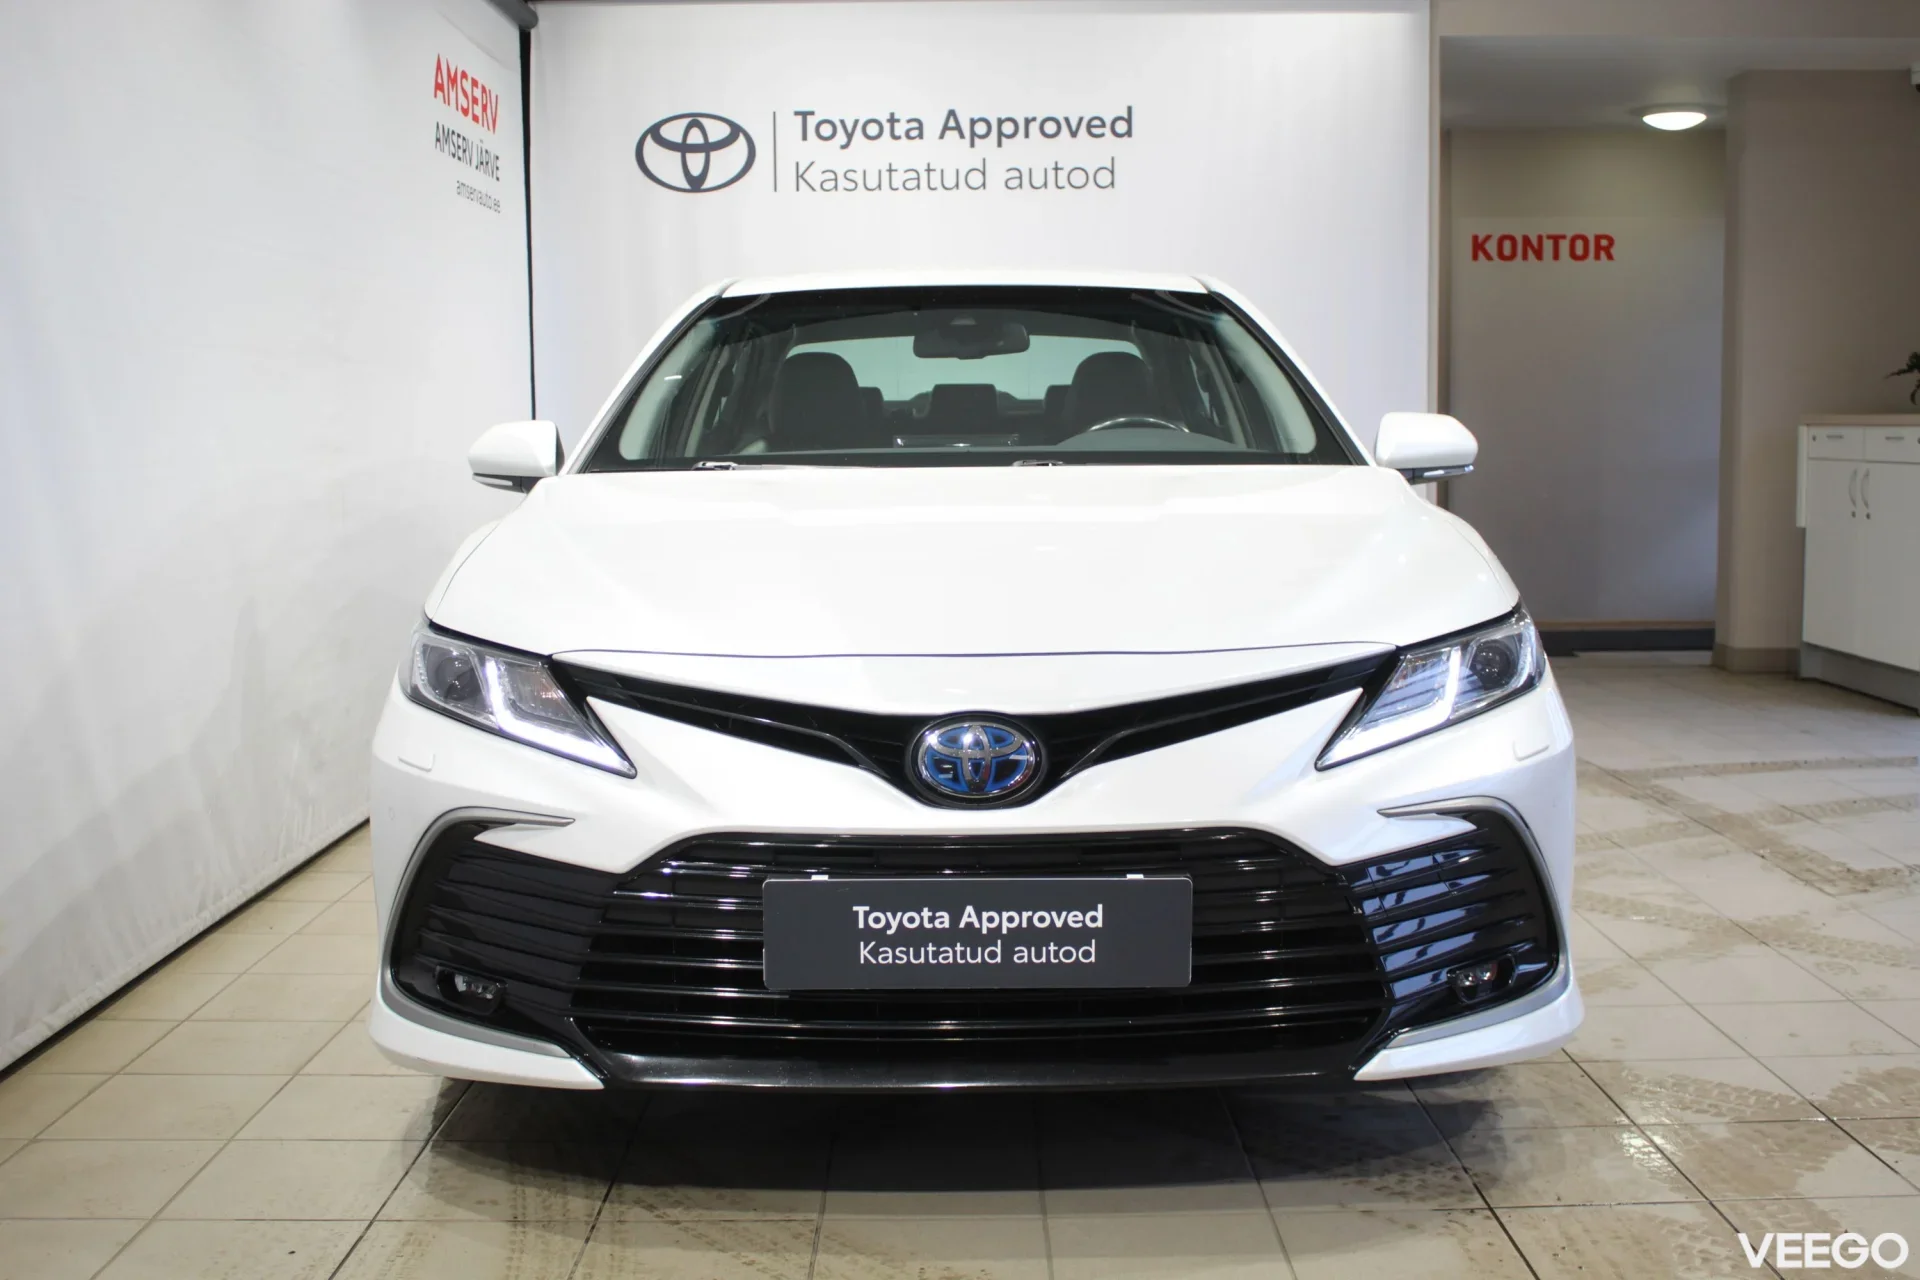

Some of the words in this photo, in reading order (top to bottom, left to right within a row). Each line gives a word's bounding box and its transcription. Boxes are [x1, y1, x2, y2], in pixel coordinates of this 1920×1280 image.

[433, 52, 499, 135] AMSERV
[793, 110, 925, 149] Toyota
[938, 105, 1134, 148] Approved
[434, 120, 474, 168] AMSERV
[474, 138, 500, 182] JÄRVE
[794, 157, 988, 193] Kasutatud
[1003, 156, 1116, 190] autod
[456, 179, 501, 214] amservauto.ee
[1471, 233, 1616, 262] KONTOR
[853, 905, 950, 934] Toyota
[959, 903, 1104, 934] Approved
[859, 939, 1002, 965] Kasutatud
[1013, 939, 1097, 964] autod
